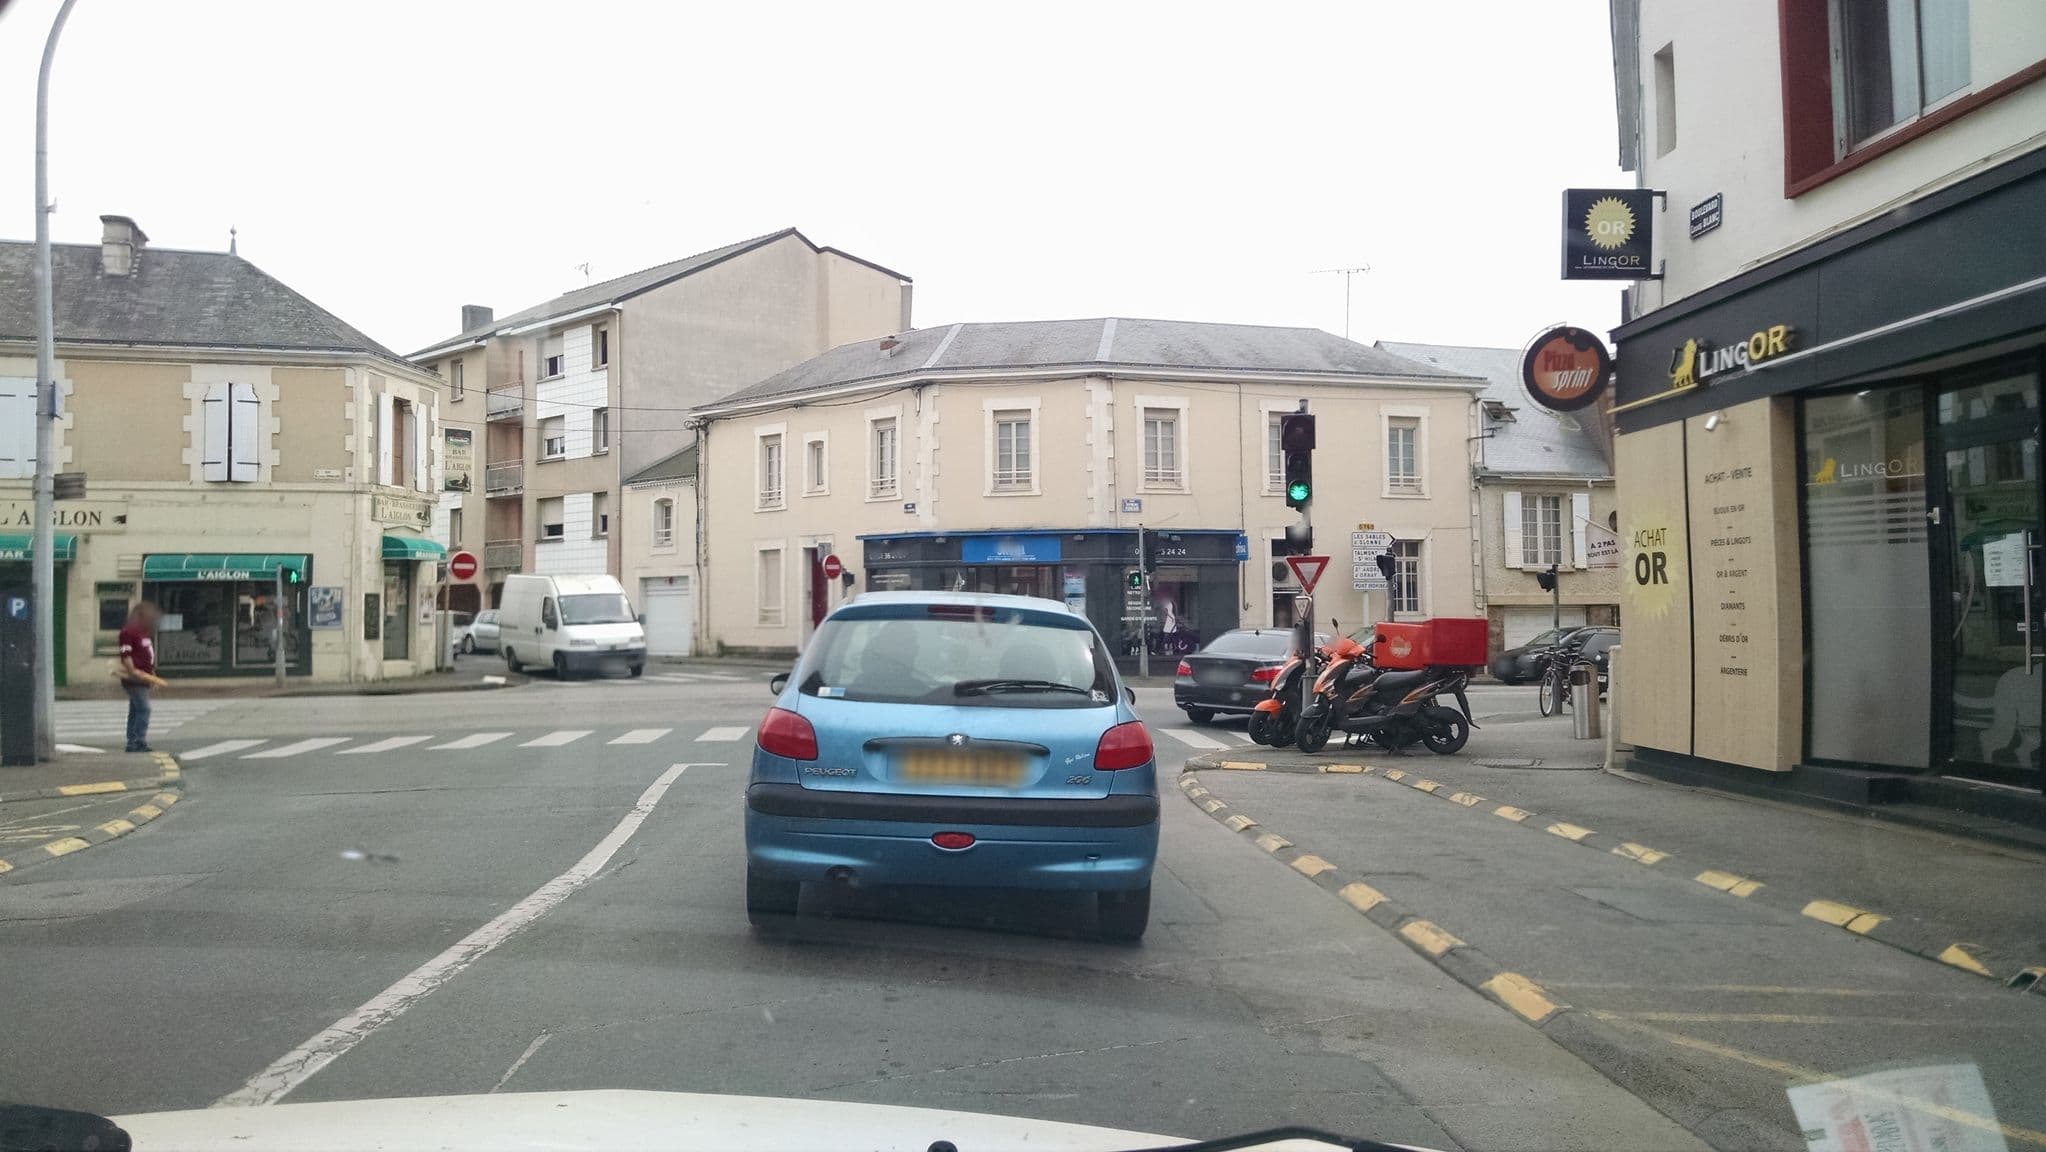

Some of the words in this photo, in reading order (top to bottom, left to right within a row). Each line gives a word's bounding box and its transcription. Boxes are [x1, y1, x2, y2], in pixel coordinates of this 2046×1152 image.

[1691, 199, 1718, 221] BOULEVARD
[1597, 220, 1626, 235] OR
[1703, 212, 1720, 228] BLANC
[1699, 325, 1787, 378] LINGOR
[1543, 351, 1575, 373] Pizza
[1551, 366, 1594, 392] sprint
[1704, 471, 1725, 484] ACHAT
[1731, 467, 1753, 480] VENTE
[1603, 539, 1616, 547] PAS
[1634, 527, 1667, 548] ACHAT
[1731, 536, 1752, 545] LINGOTS
[197, 570, 250, 580] L'AIGLON
[1635, 551, 1669, 586] OR
[1716, 570, 1723, 578] OR
[1729, 569, 1748, 578] ARGENT
[12, 598, 26, 616] P
[1720, 602, 1746, 611] DIAMANTS
[1720, 666, 1748, 676] ARGENTERIE
[804, 767, 858, 777] PEUGEOT
[1066, 775, 1092, 785] 206
